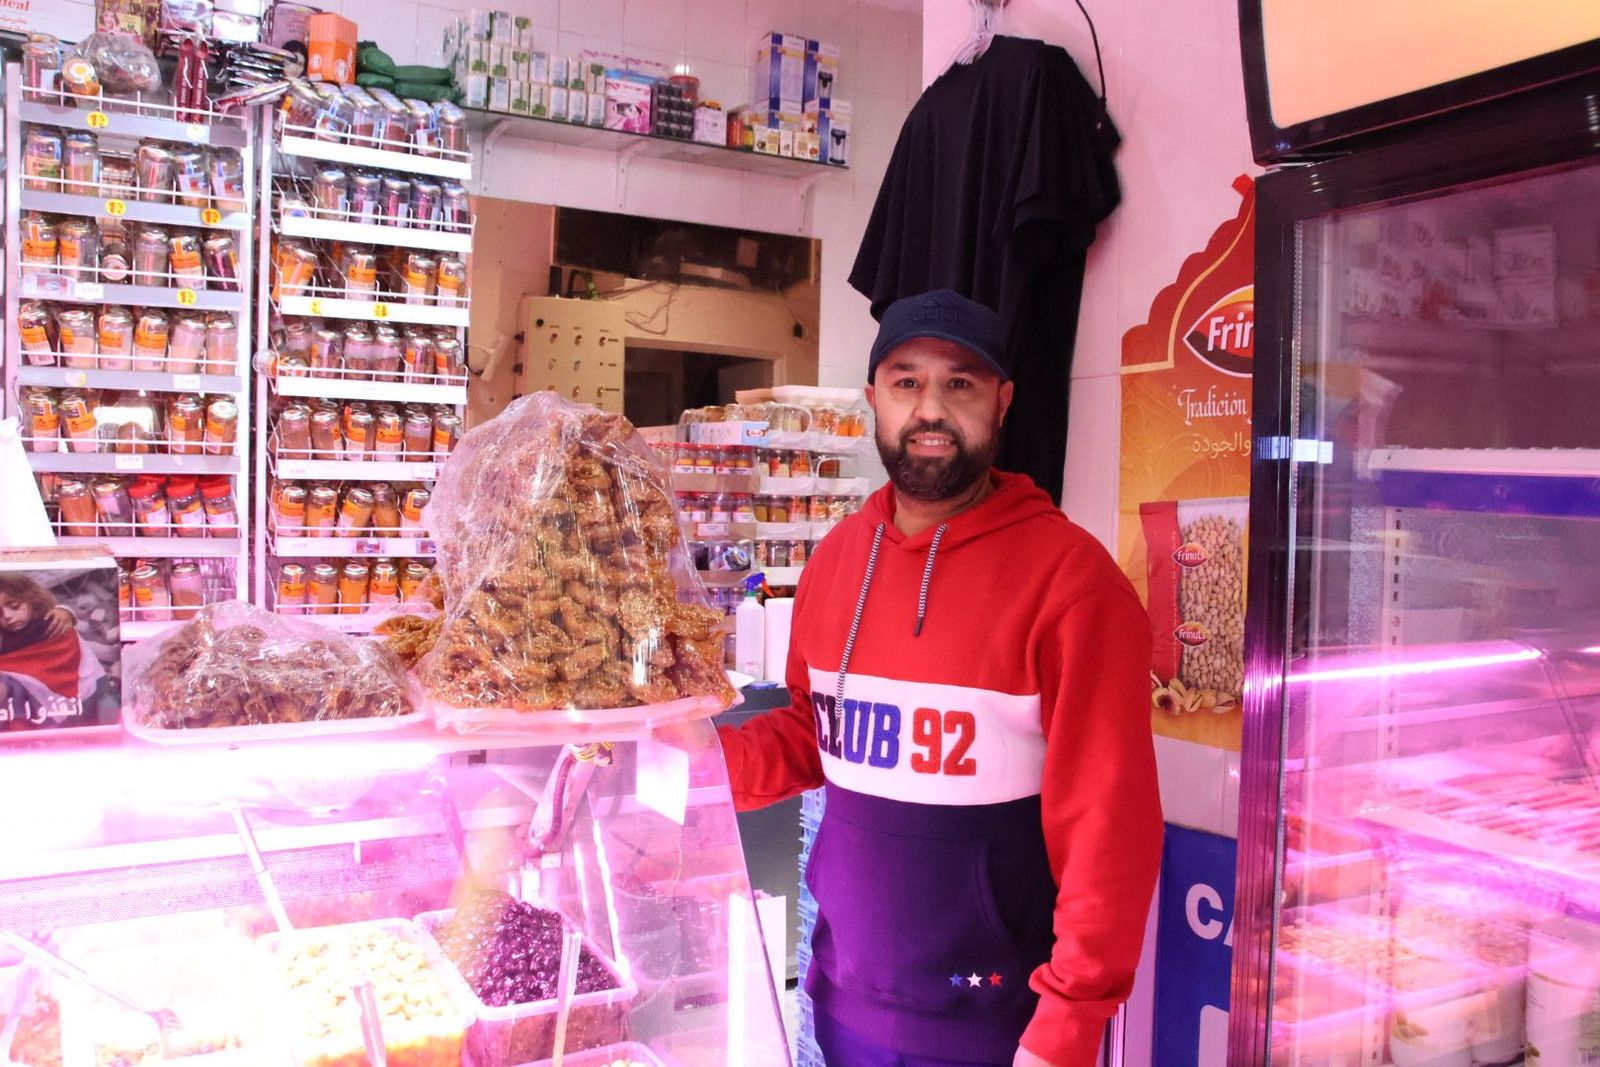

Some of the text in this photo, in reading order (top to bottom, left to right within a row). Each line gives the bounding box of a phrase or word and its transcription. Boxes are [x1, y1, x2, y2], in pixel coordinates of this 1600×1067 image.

[1178, 385, 1248, 426] Tradición
[1192, 431, 1251, 459] والجودة
[1177, 550, 1205, 561] Frinuts
[1179, 629, 1206, 640] Frinuts
[811, 691, 977, 776] CLUB 92
[1185, 882, 1234, 947] C
